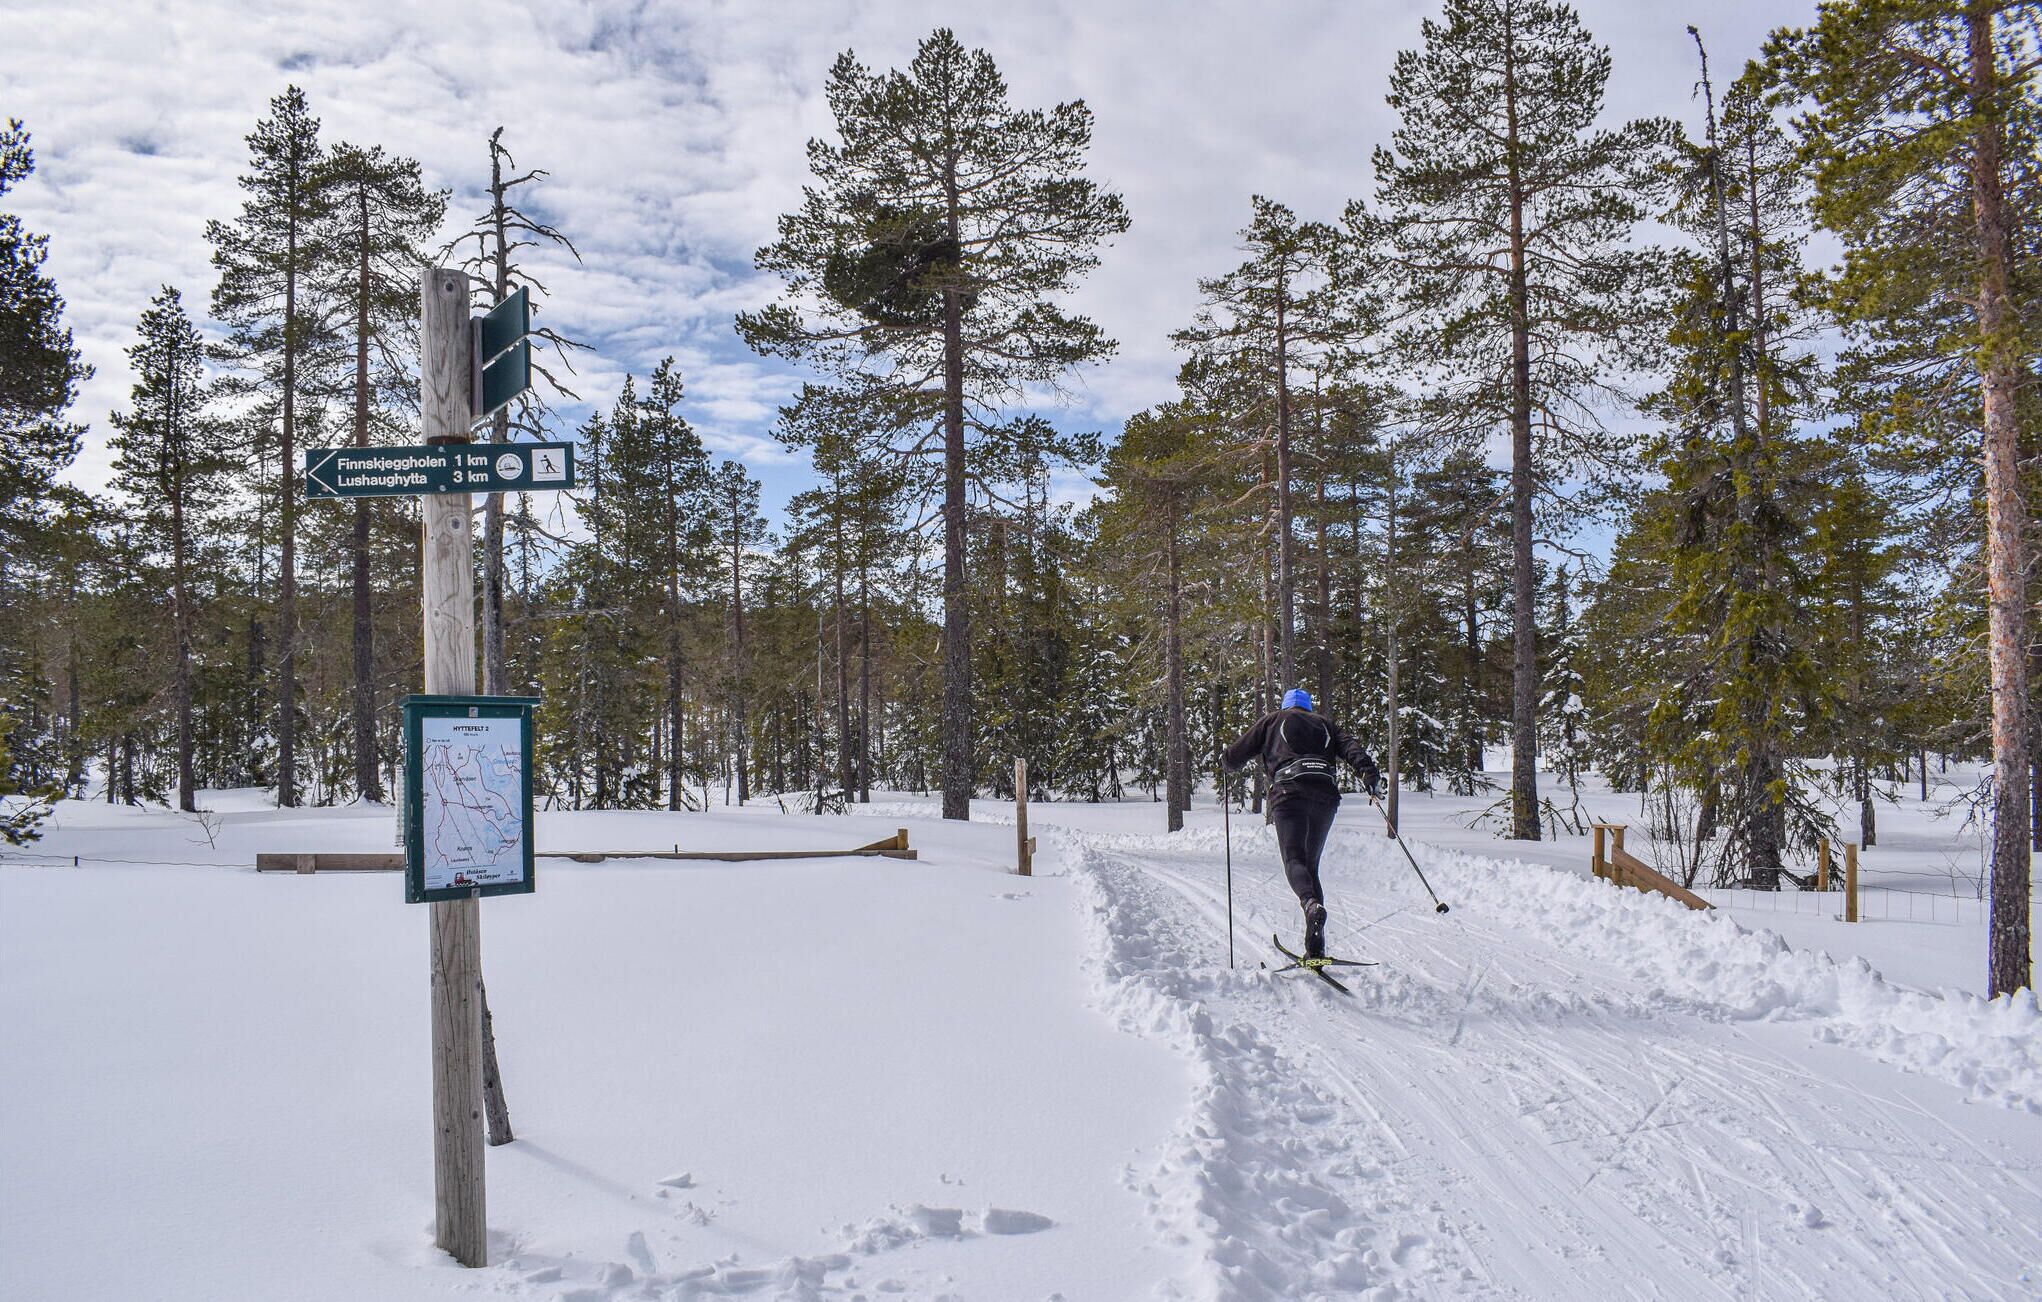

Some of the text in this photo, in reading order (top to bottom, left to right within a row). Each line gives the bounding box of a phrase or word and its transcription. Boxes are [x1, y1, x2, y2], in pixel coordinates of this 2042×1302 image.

[337, 456, 447, 471] Finnskjeggholen
[454, 454, 462, 467] 1
[467, 454, 488, 466] km
[337, 470, 489, 487] Lushaughytta 3 km
